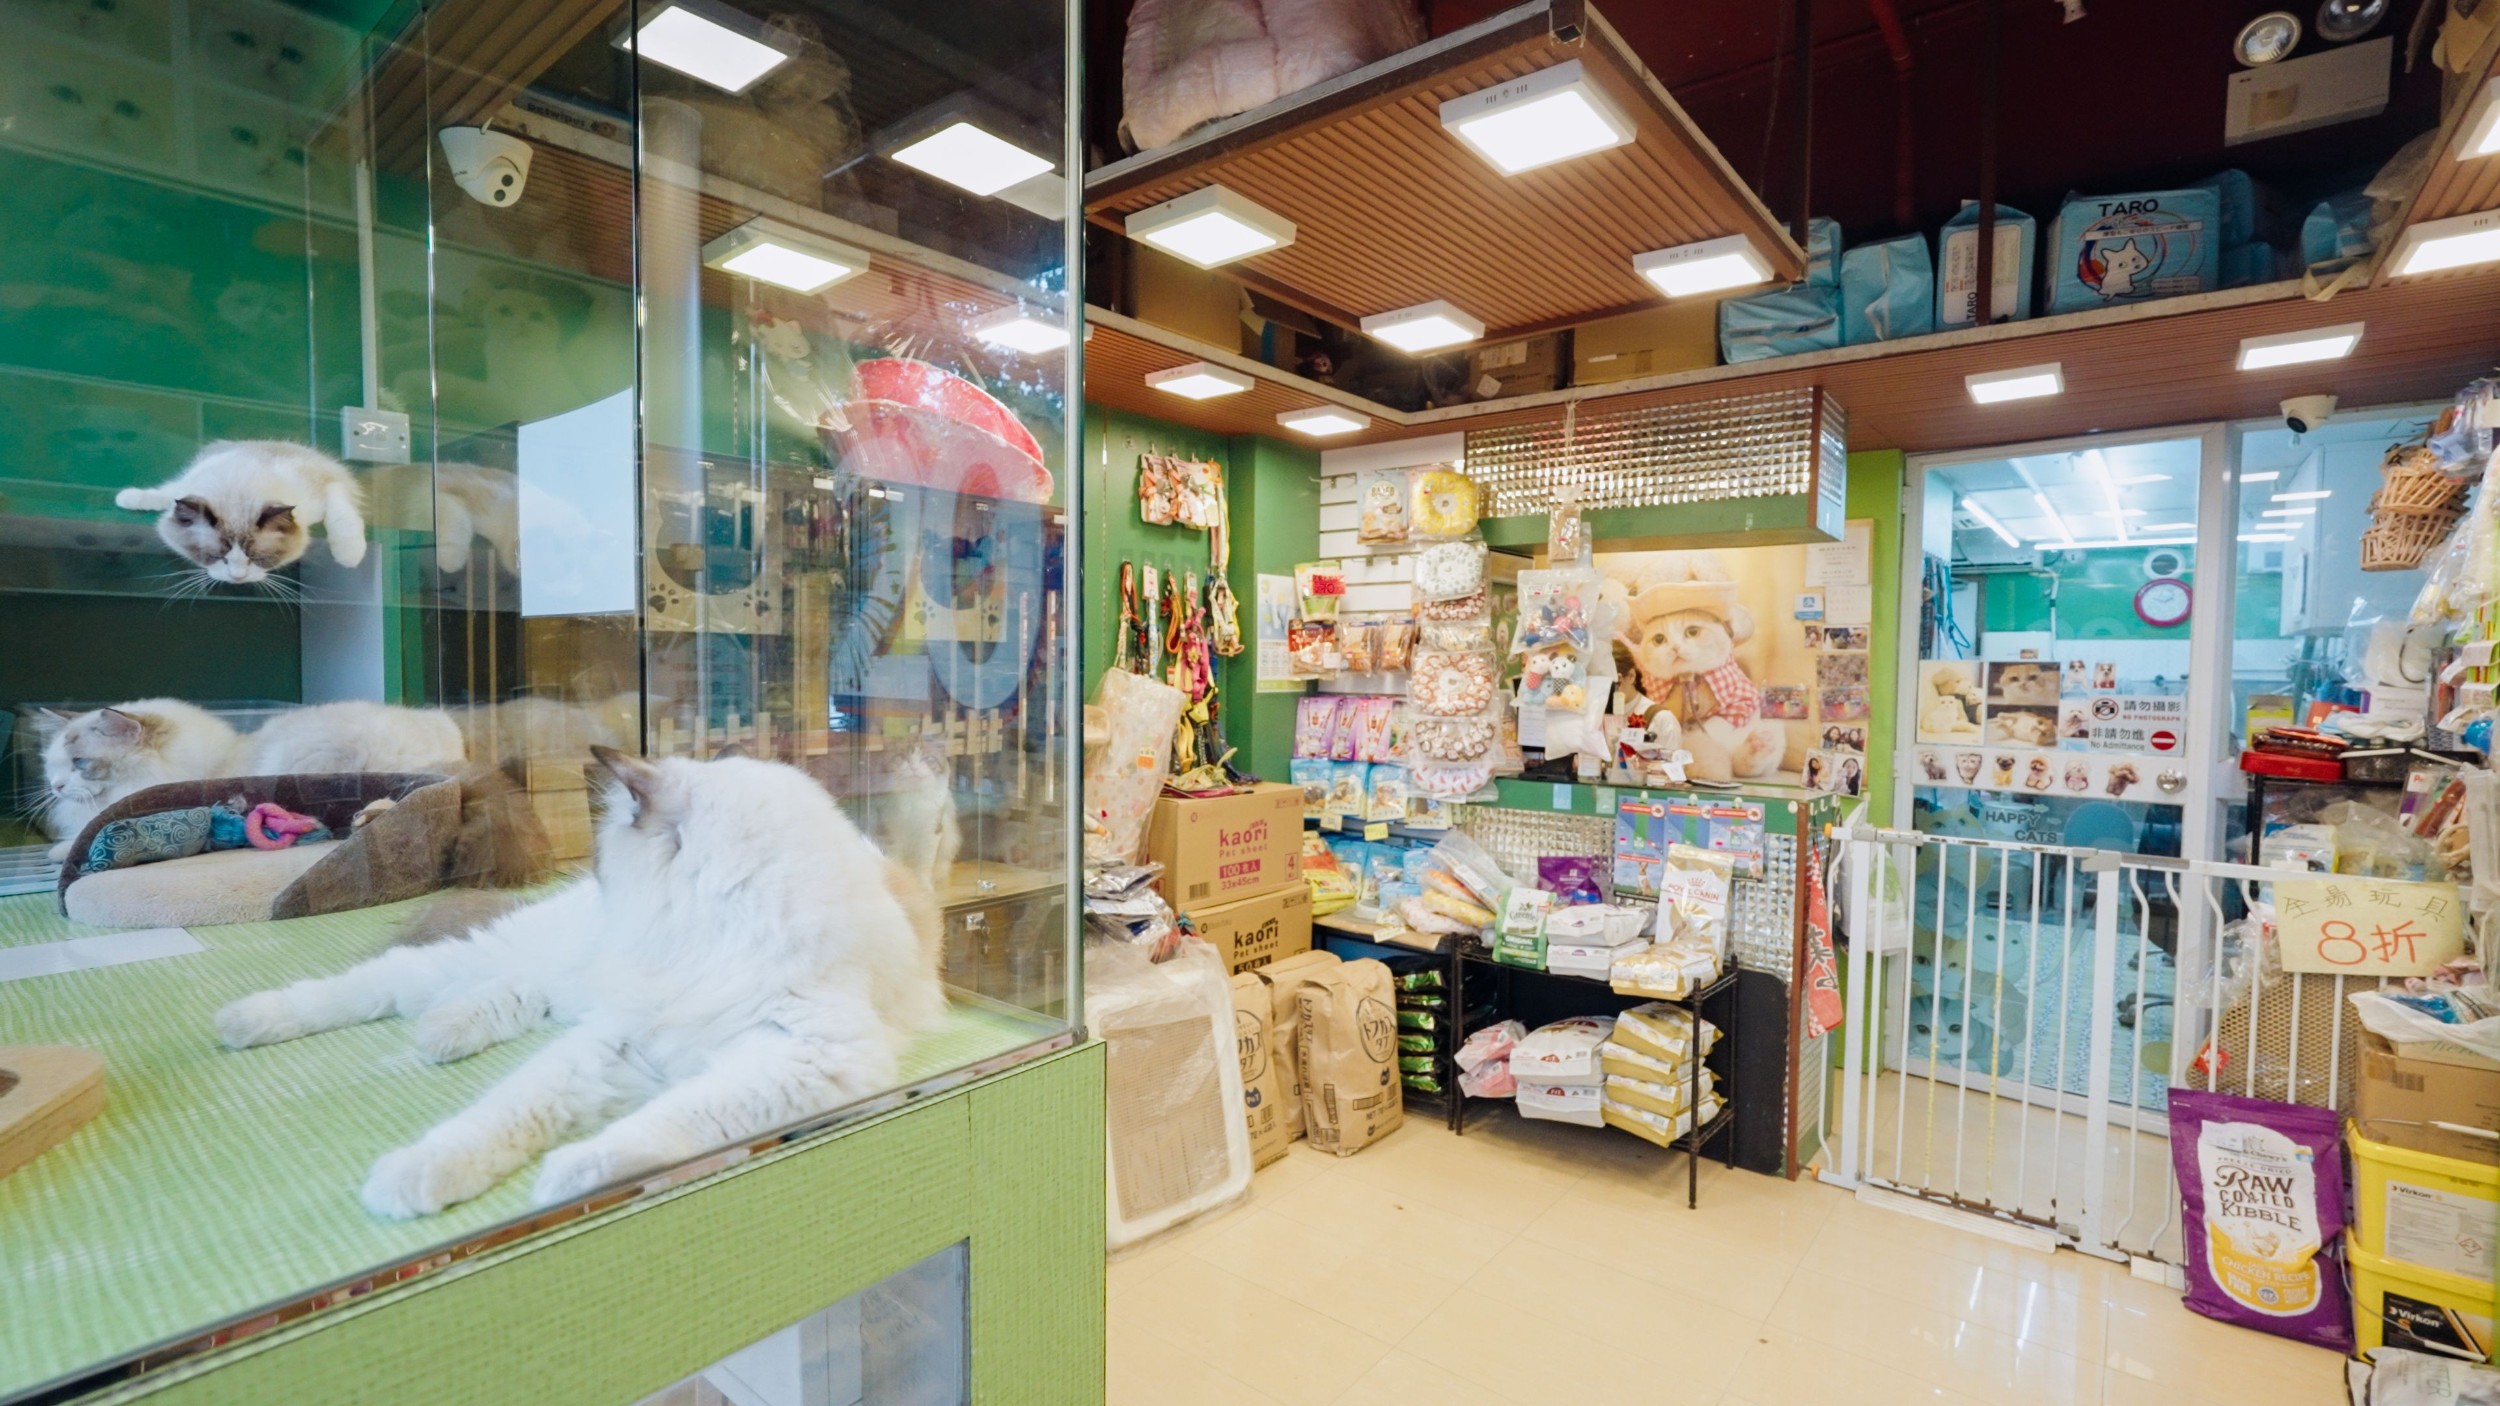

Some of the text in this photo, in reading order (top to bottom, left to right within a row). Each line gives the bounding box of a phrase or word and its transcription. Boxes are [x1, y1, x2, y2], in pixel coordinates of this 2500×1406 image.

[2098, 199, 2158, 217] TARO
[1966, 291, 1977, 320] TARO
[2124, 700, 2181, 712] 請勿攝影
[2092, 727, 2145, 741] 非請勿進
[2091, 741, 2145, 751] No Admittance
[1985, 811, 2040, 827] HAPPY
[1219, 822, 1268, 848] kaori
[2014, 830, 2058, 844] CATS
[1219, 843, 1268, 859] Pet sheet
[1667, 882, 1720, 901] ROYL CANIN
[1234, 920, 1279, 949] kaori
[2317, 919, 2427, 966] 8折
[1233, 940, 1279, 960] Pet sheet
[2213, 1165, 2294, 1195] RAW
[2219, 1189, 2294, 1209] COATED
[2399, 1187, 2432, 1199] Virkon
[2221, 1202, 2302, 1232] KIBBLE
[2222, 1256, 2272, 1280] CHICKEN
[2398, 1308, 2440, 1328] Virkon
